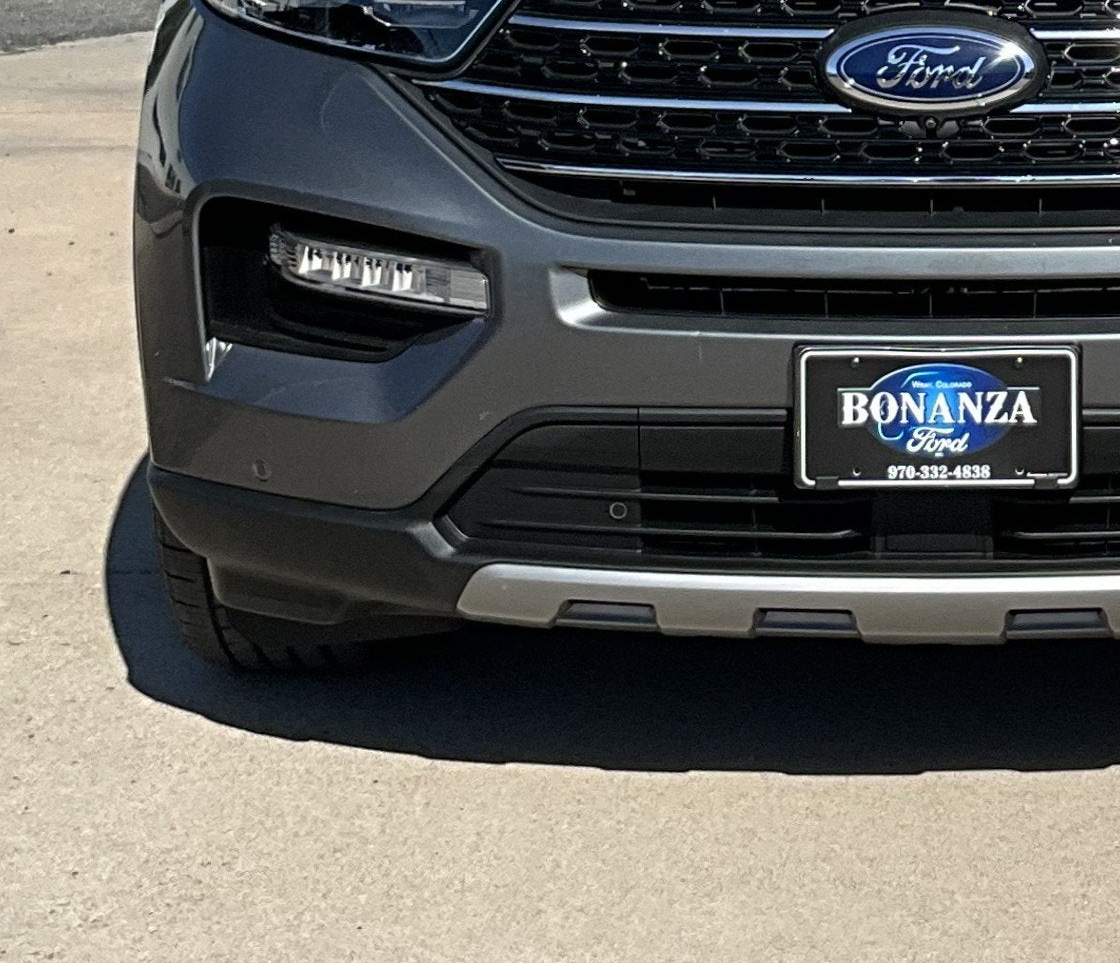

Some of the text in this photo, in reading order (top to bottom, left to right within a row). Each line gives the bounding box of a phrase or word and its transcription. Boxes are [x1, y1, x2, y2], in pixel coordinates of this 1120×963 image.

[877, 44, 987, 88] Ford
[841, 391, 1038, 425] BONANZA
[906, 427, 969, 453] Ford
[887, 465, 991, 479] 970-332-4838
